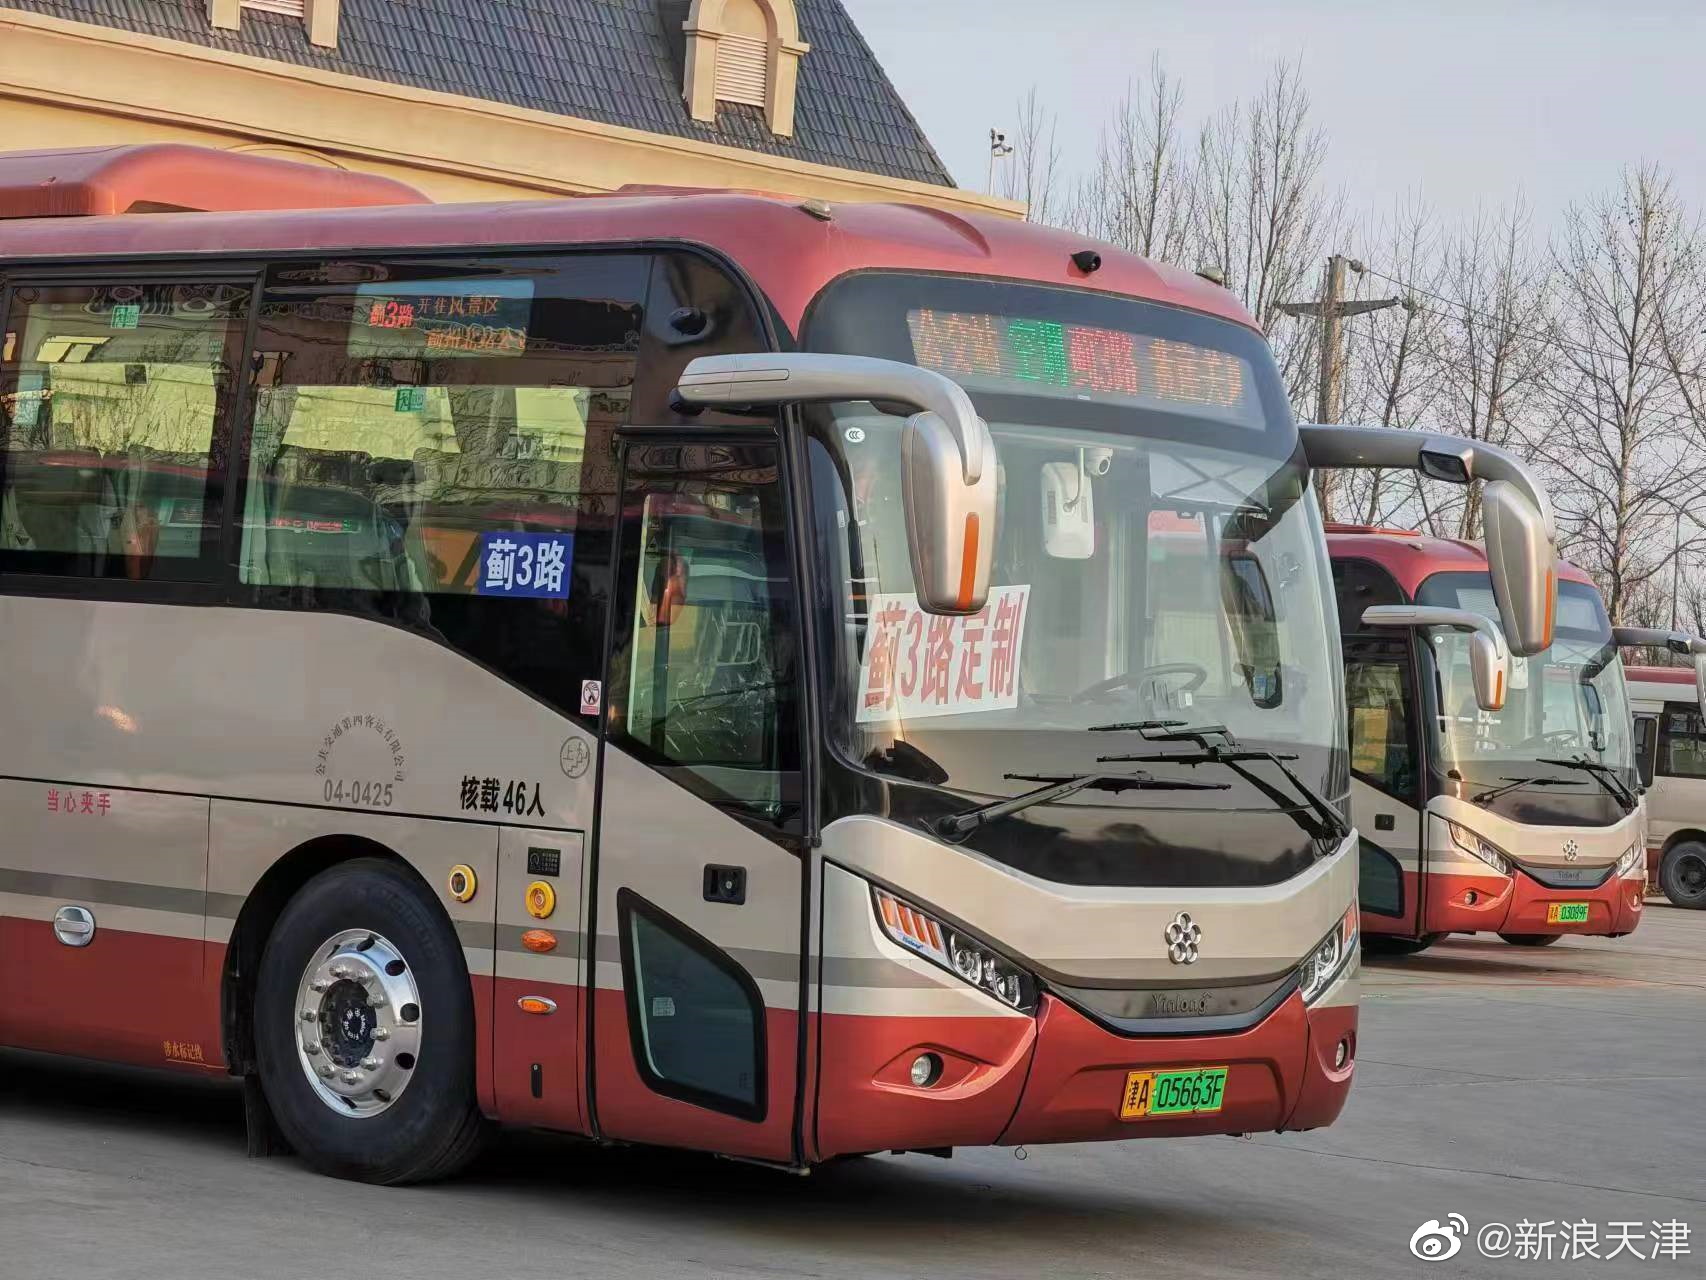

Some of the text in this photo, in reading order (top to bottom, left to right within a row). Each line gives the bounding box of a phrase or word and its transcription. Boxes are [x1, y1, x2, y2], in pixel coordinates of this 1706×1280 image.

[485, 538, 566, 592] 蓟3路
[864, 592, 1024, 711] 蓟3路定制
[48, 788, 111, 816] 当心夹手
[324, 779, 393, 807] 04-0425
[460, 775, 546, 818] 核载46人
